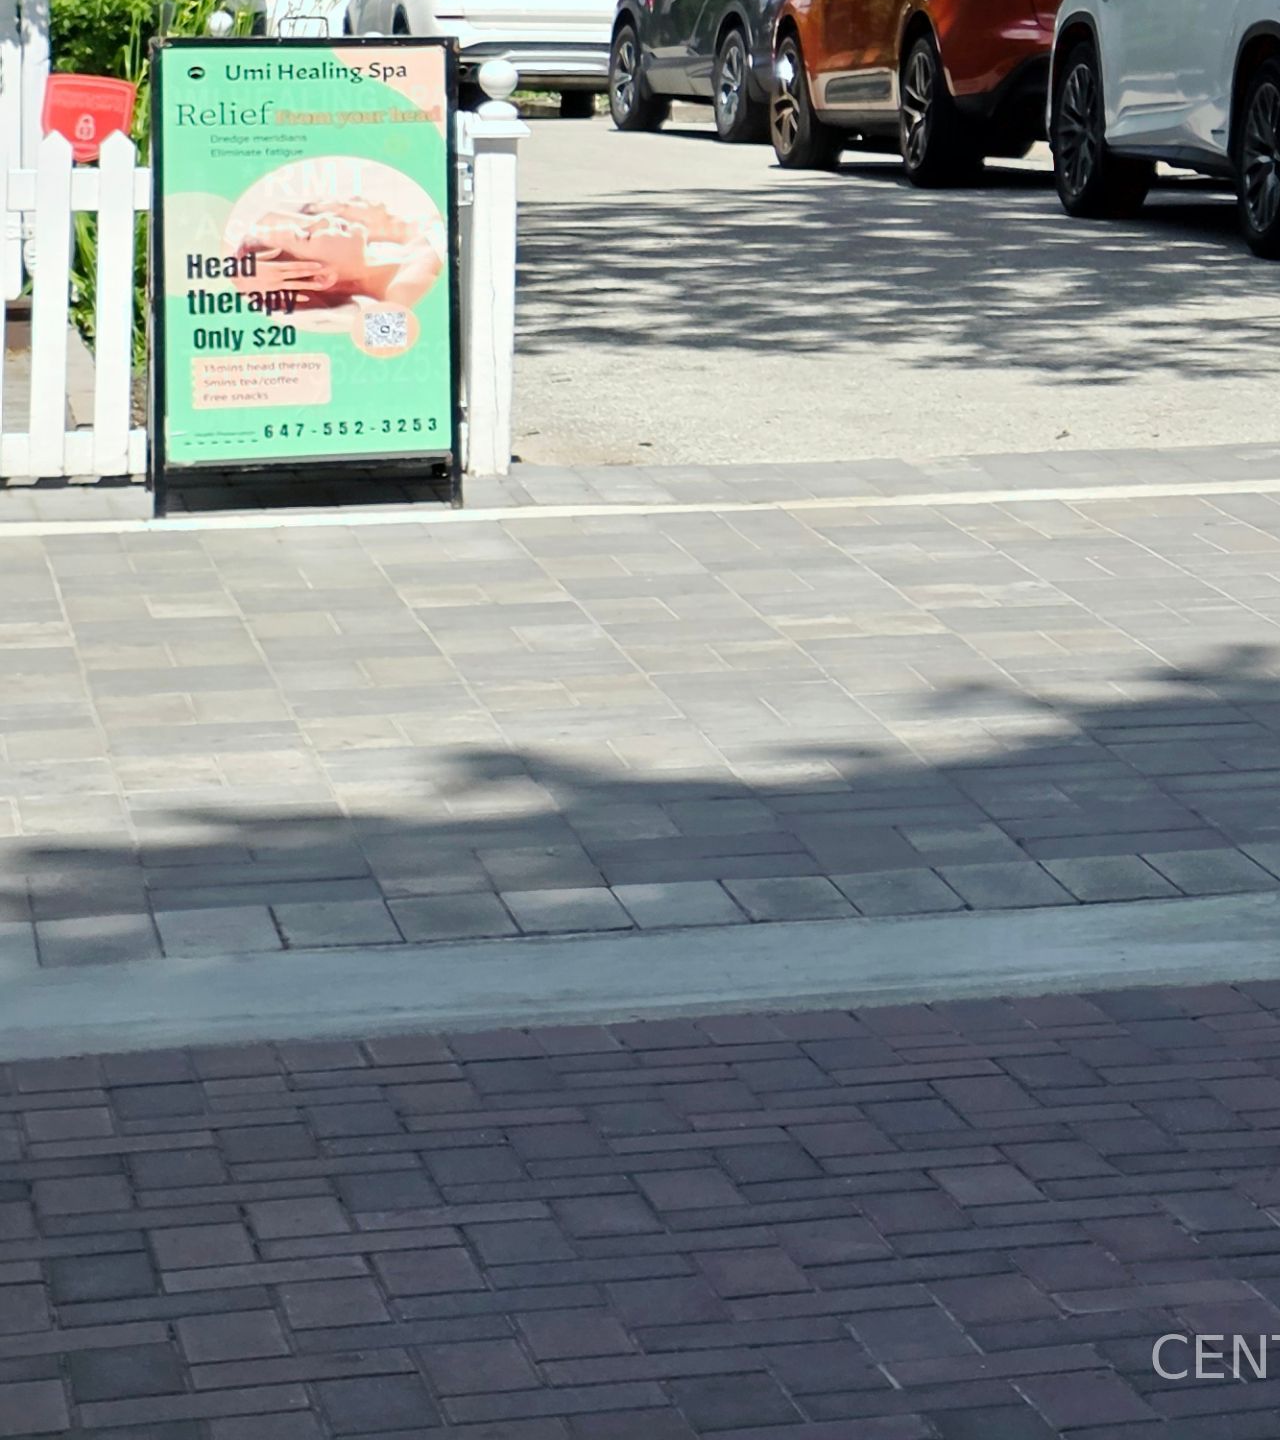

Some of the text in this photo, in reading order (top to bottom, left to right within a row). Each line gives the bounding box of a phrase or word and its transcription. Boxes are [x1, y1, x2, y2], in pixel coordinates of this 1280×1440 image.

[225, 62, 408, 84] Umi Healing Spa
[176, 101, 275, 127] Relief
[186, 253, 257, 280] Head
[186, 289, 301, 316] therapy
[193, 324, 297, 352] Only $20
[203, 393, 229, 403] Free
